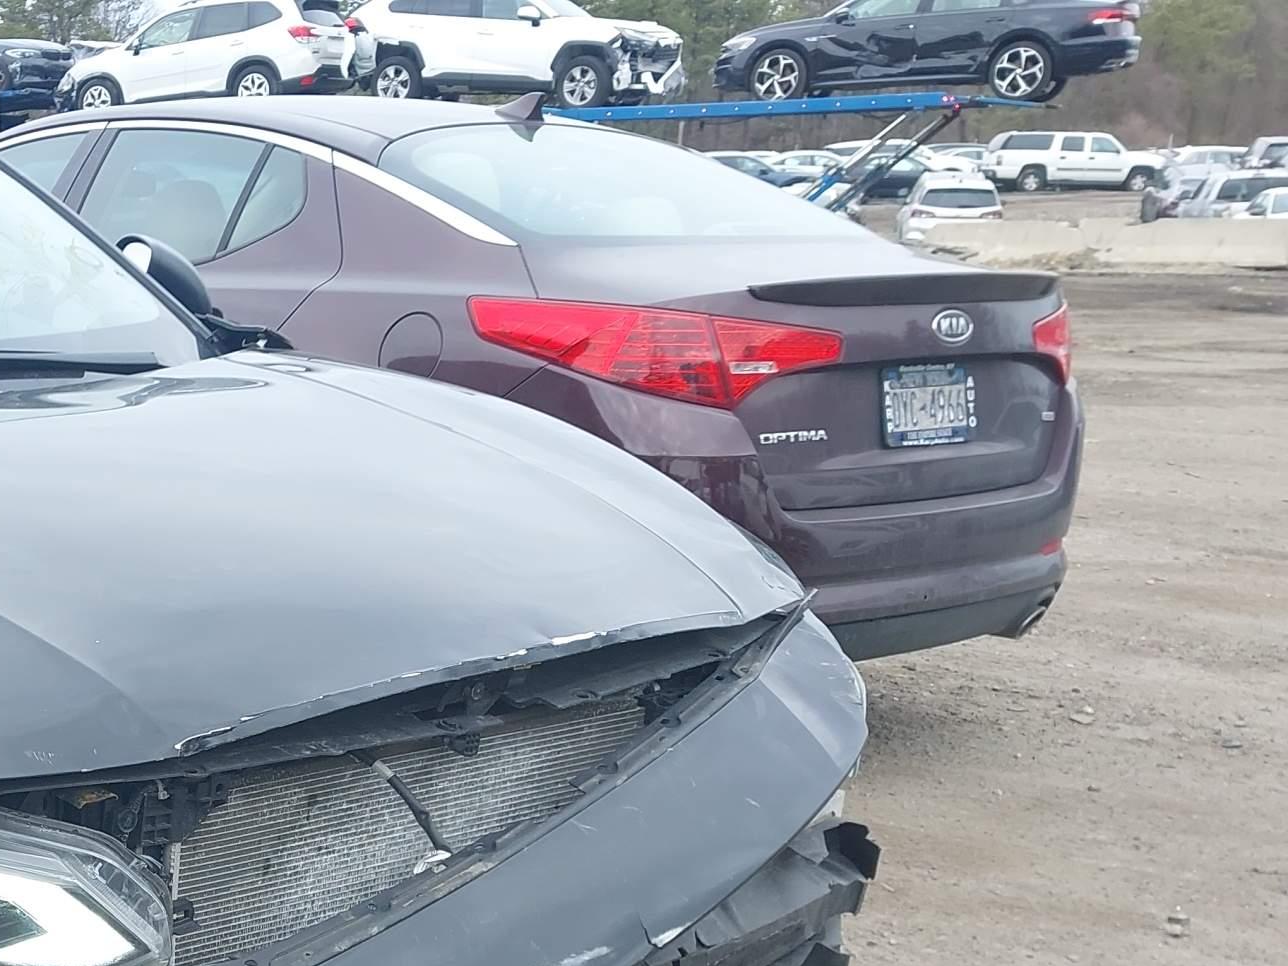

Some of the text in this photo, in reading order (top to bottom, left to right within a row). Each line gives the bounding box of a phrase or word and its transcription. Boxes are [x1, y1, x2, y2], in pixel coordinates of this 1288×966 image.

[939, 316, 967, 334] KIA
[966, 376, 978, 428] AUTO
[759, 429, 829, 445] OPTIMA
